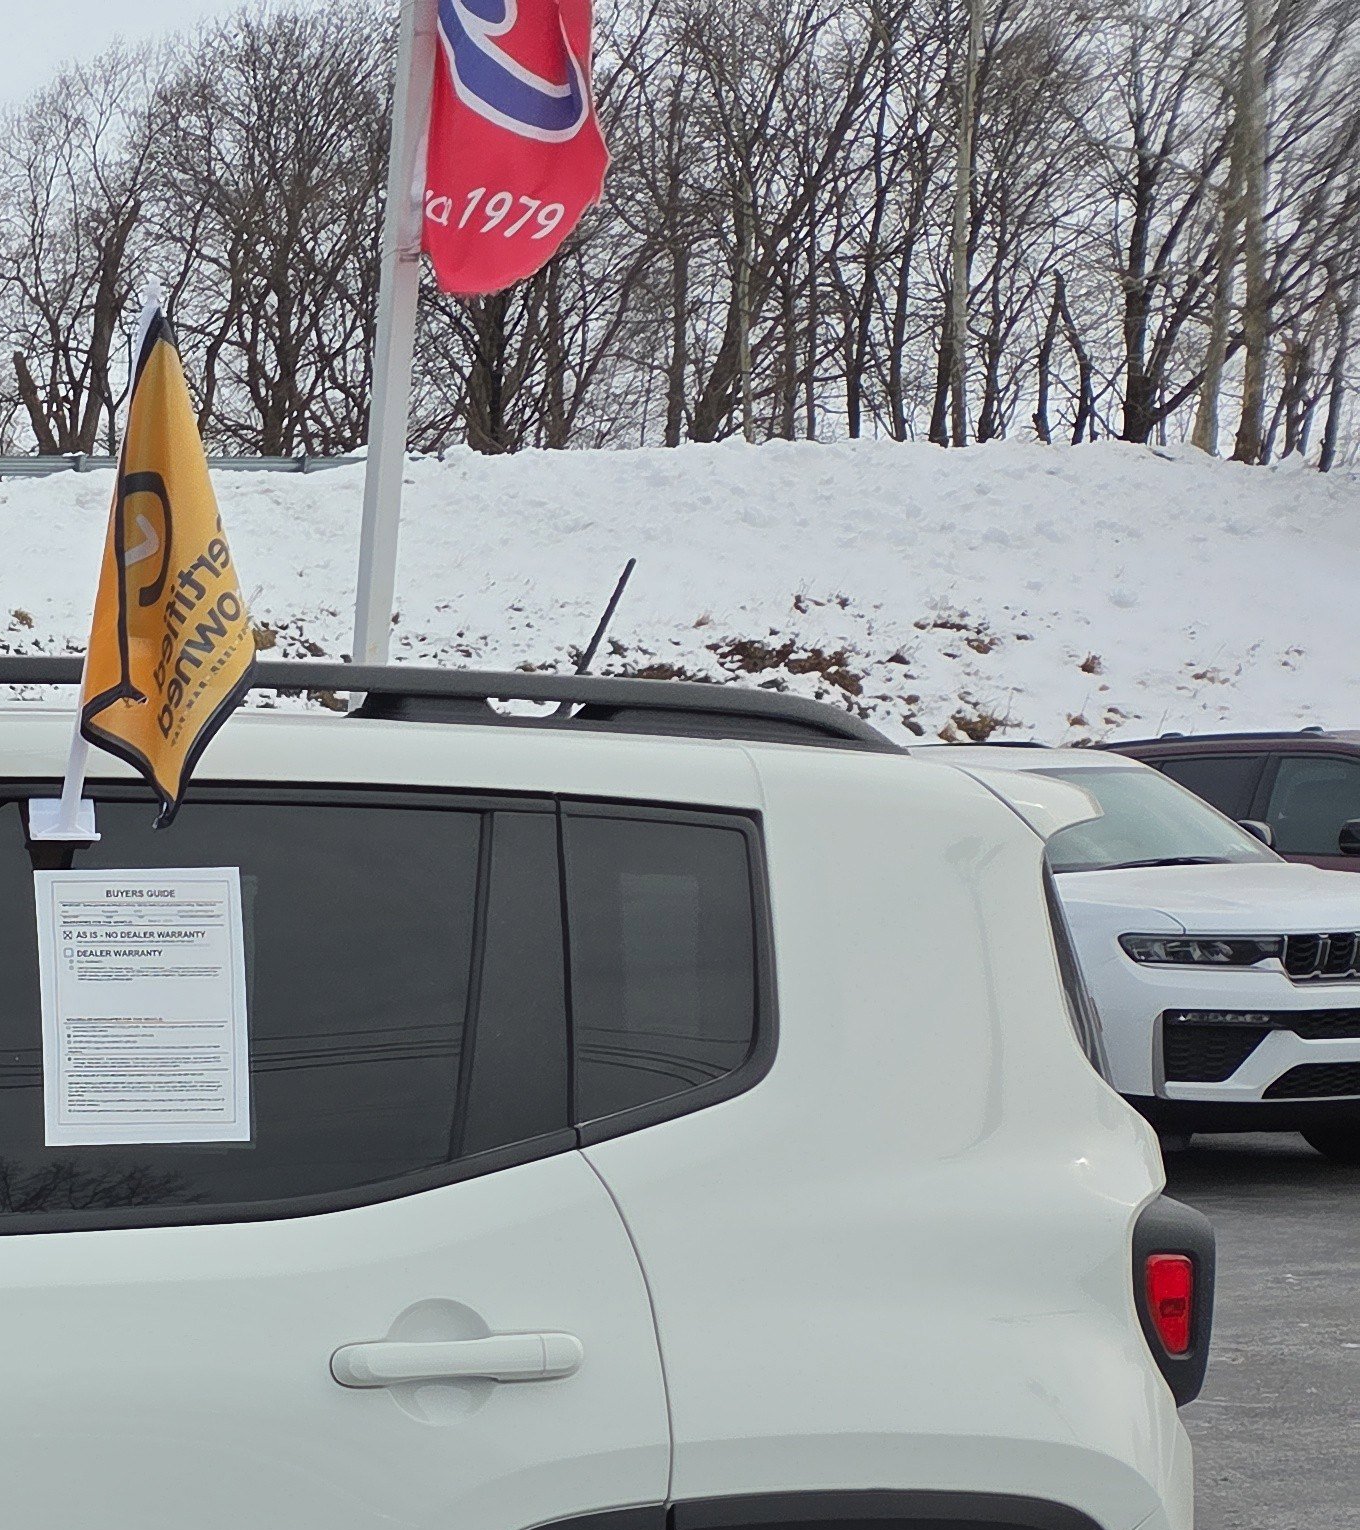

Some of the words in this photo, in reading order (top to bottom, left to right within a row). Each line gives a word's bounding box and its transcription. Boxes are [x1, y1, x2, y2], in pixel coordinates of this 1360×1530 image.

[458, 187, 565, 239] 1979
[105, 889, 144, 898] BUYERS
[146, 889, 176, 898] GUIDE
[76, 931, 87, 939] AS
[89, 931, 98, 939] IS
[105, 931, 118, 939] NO
[120, 931, 155, 939] DEALER
[157, 930, 206, 939] WARRANTY
[76, 949, 112, 958] DEALER
[113, 949, 163, 957] WARRANTY
